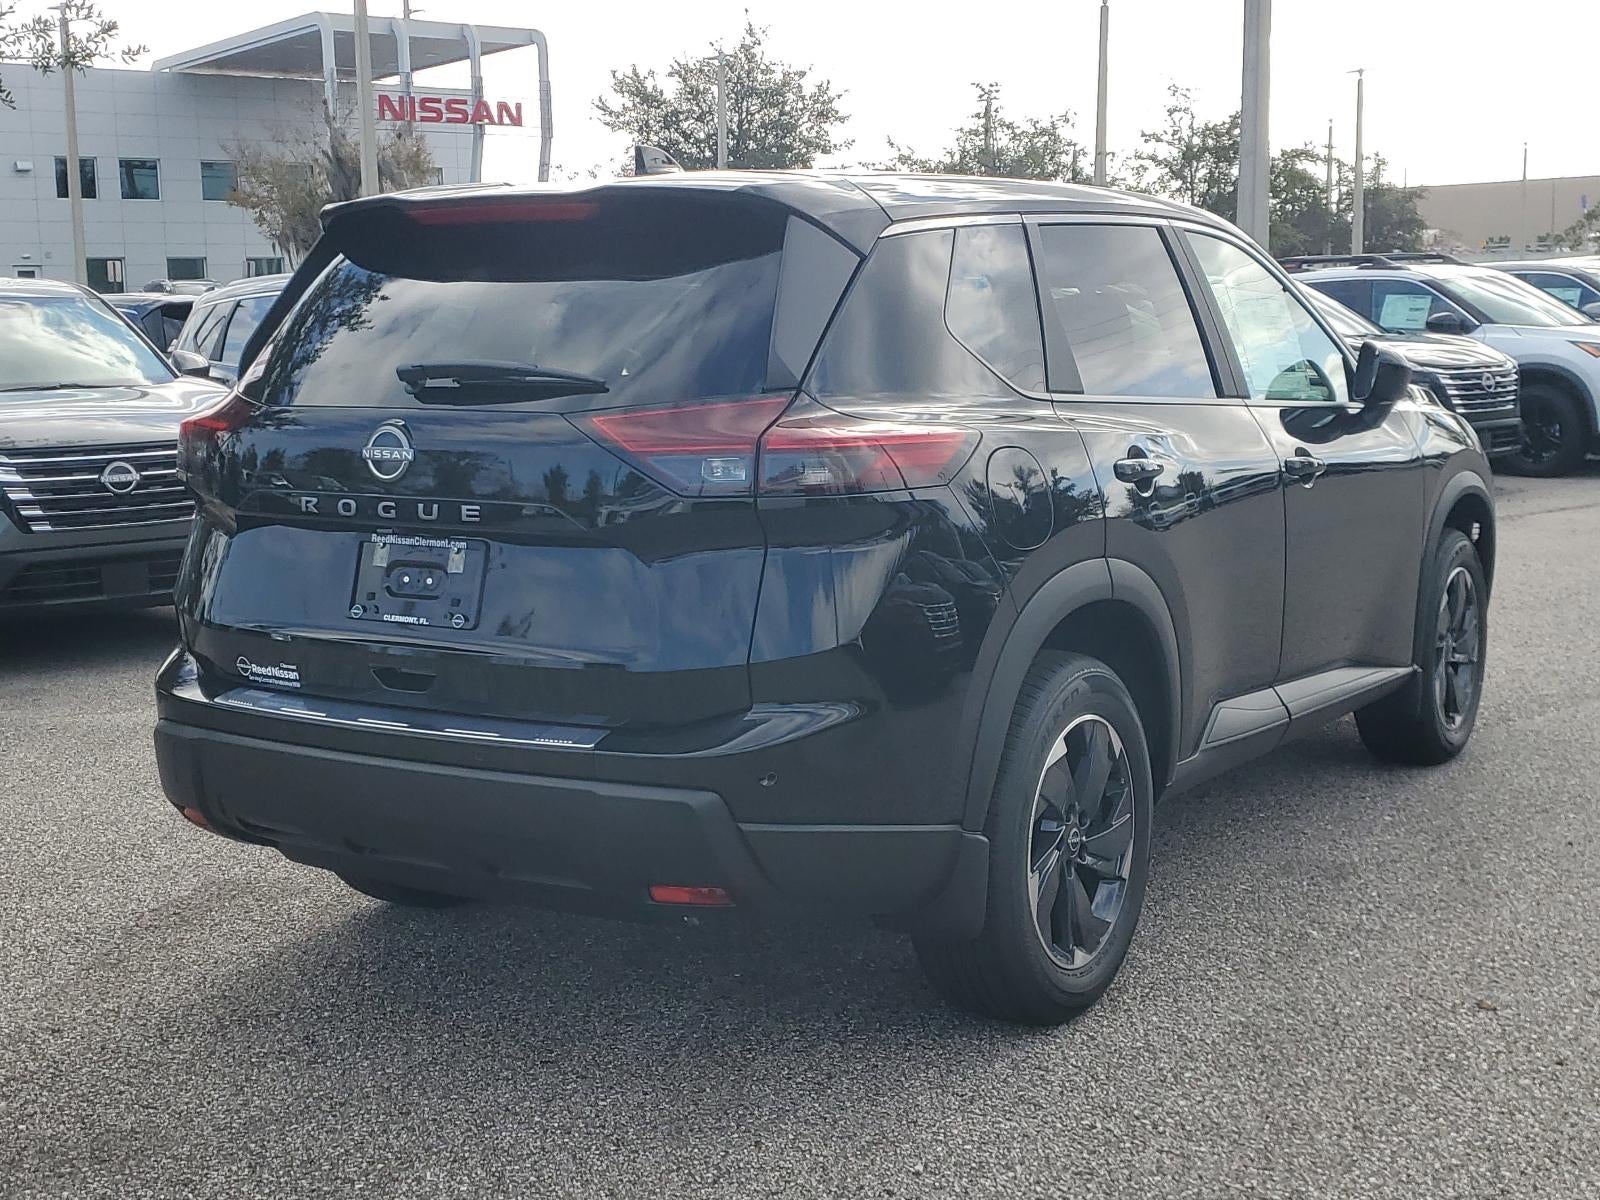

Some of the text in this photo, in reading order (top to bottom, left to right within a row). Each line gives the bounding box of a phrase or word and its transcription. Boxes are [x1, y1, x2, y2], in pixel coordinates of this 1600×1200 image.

[378, 94, 523, 127] NISSAN
[362, 449, 412, 460] NISSAN
[300, 496, 481, 522] ROGUE
[371, 533, 467, 549] ReedNissanClermont.com
[383, 614, 418, 625] CLERMONT,
